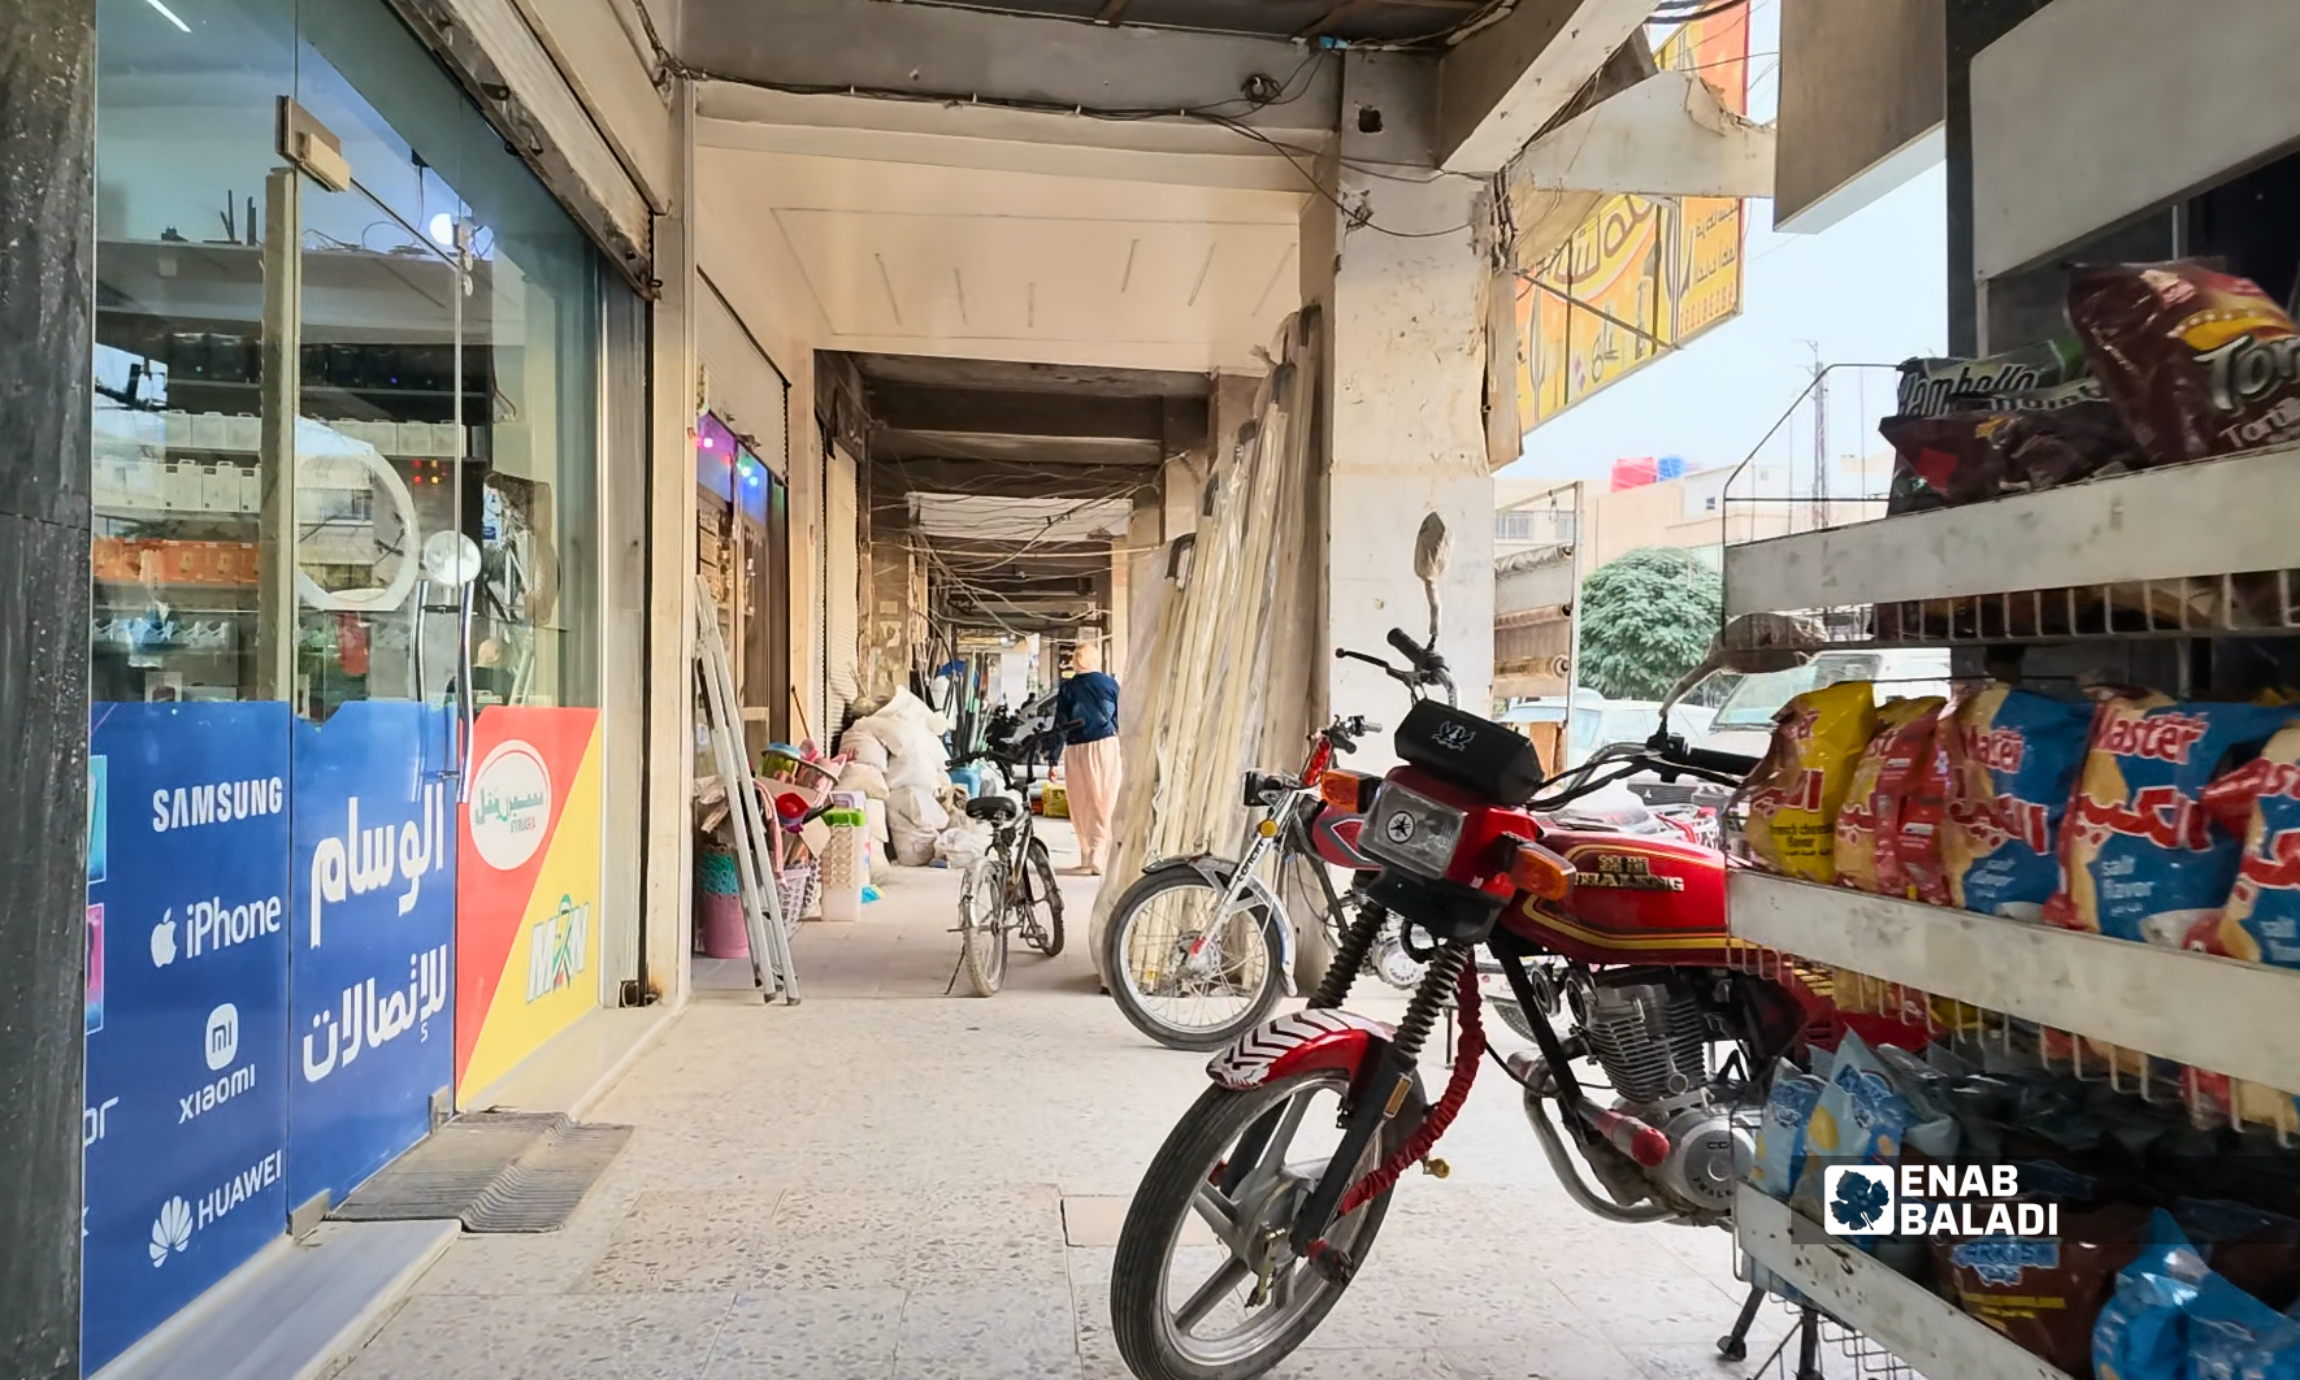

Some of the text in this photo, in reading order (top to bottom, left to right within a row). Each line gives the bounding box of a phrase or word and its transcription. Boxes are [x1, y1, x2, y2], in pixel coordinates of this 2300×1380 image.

[153, 776, 283, 832] SAMSUNG
[311, 782, 443, 949] الوسام
[187, 896, 281, 960] iPhone
[198, 1150, 282, 1231] HUAWEI
